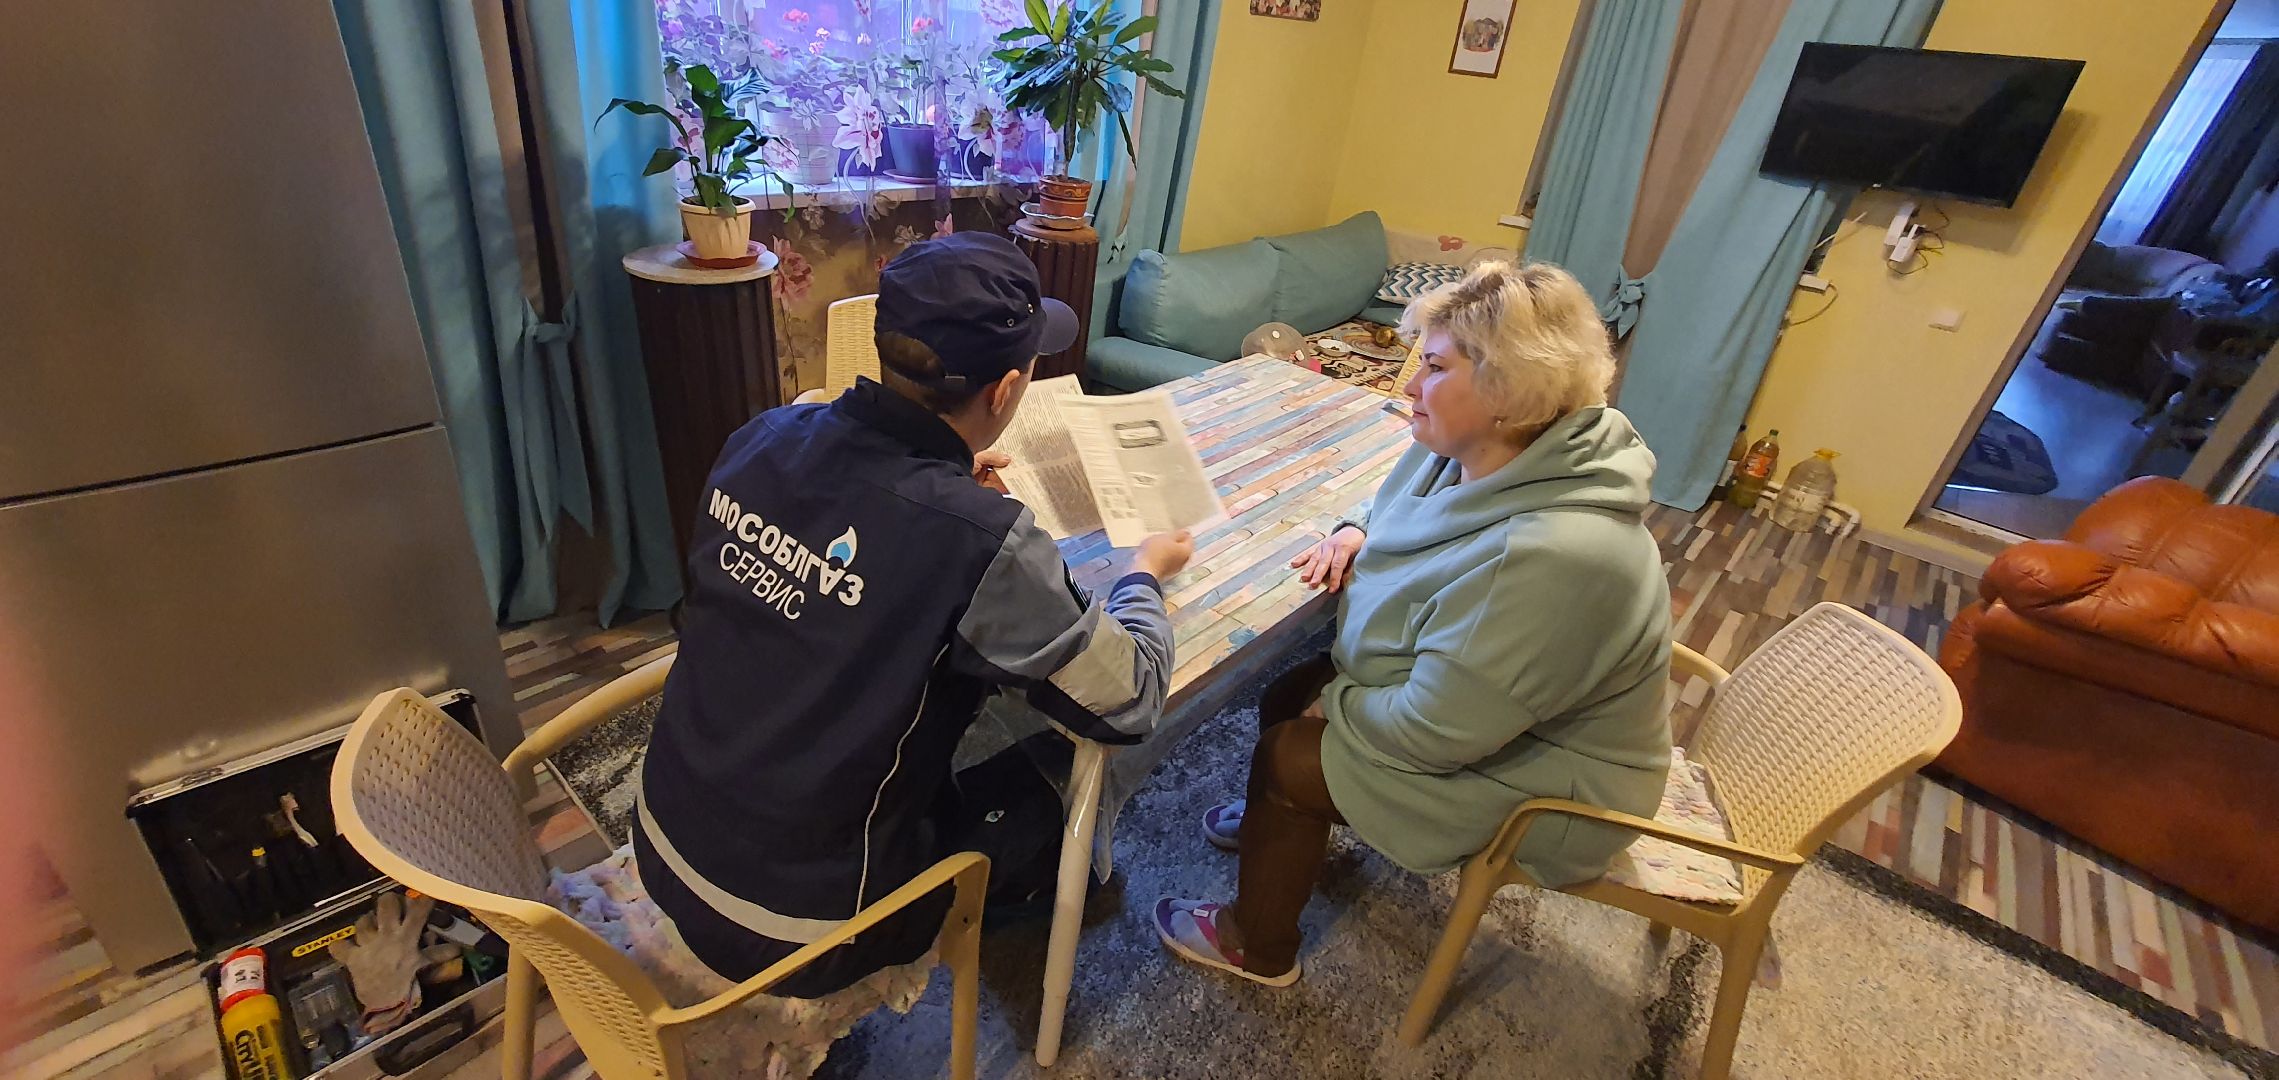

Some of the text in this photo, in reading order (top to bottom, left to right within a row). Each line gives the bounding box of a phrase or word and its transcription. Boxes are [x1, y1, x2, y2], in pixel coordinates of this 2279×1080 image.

[708, 487, 865, 607] МОСОБЛГАЗ
[719, 542, 805, 620] СЕРВИС
[297, 928, 352, 954] STANLEY
